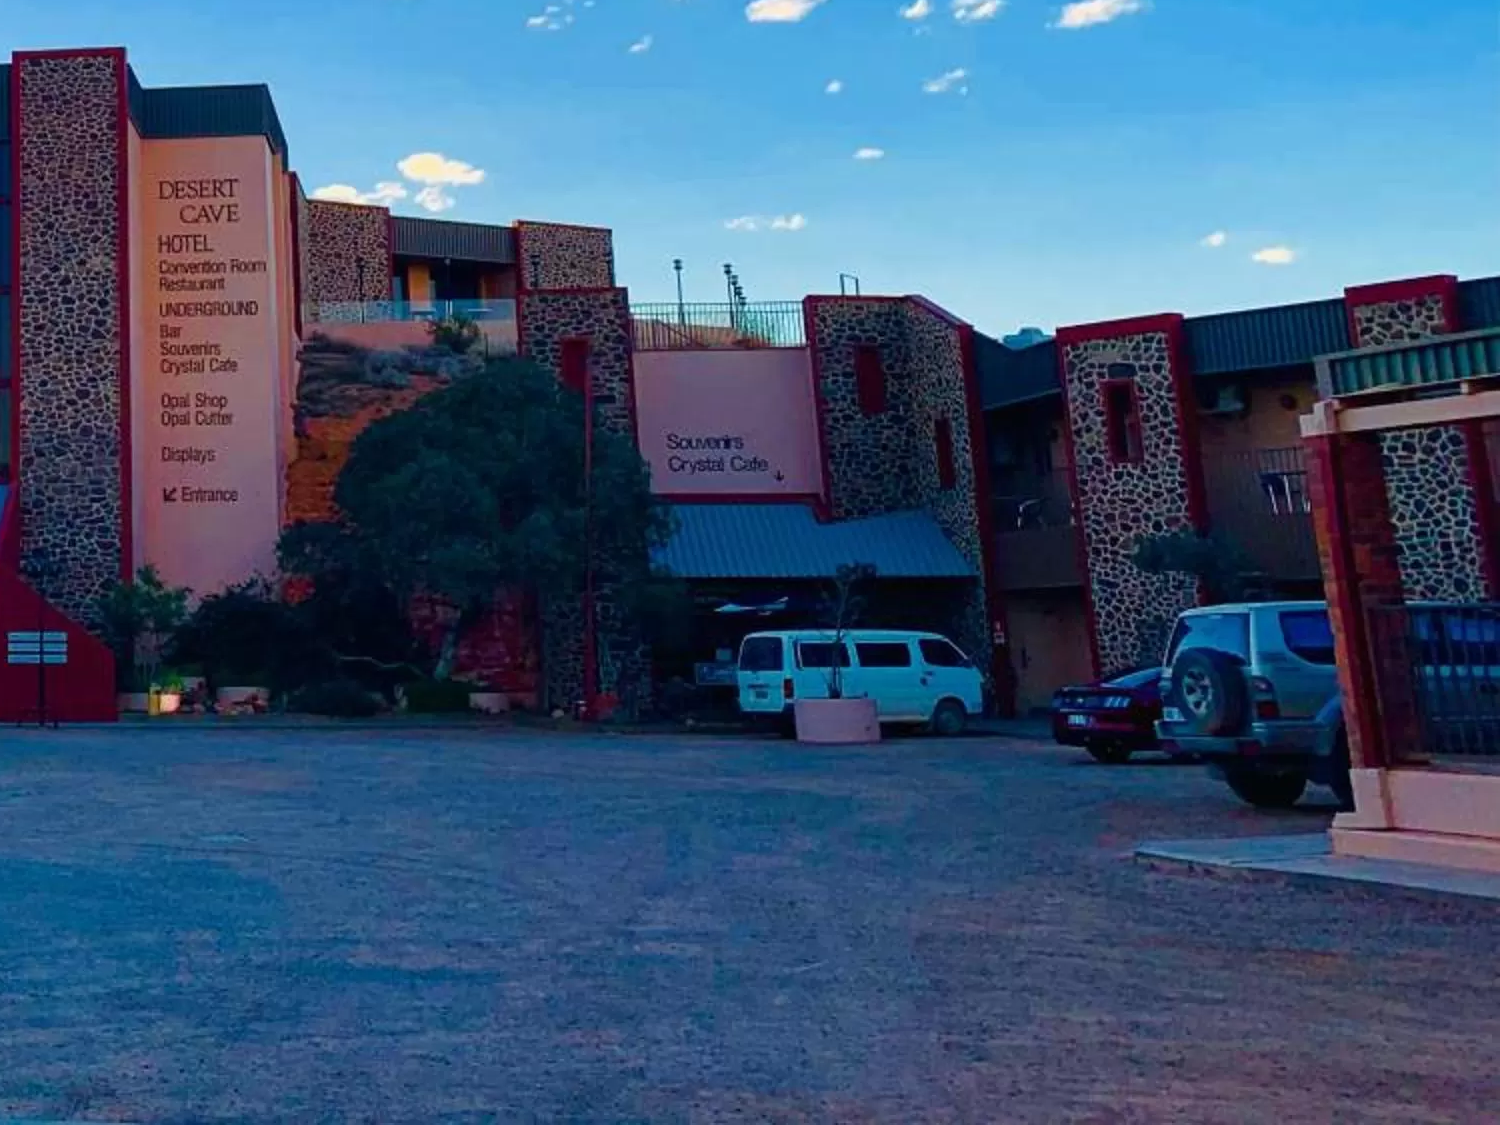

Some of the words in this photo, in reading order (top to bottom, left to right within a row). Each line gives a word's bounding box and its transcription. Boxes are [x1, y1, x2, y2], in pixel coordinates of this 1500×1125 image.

[158, 178, 240, 200] DESERT
[179, 203, 240, 224] CAVE
[157, 234, 215, 254] HOTEL
[158, 259, 226, 274] Convention
[230, 259, 267, 272] Room
[159, 277, 225, 292] Restaurant
[159, 301, 258, 317] UNDERGROUND
[159, 325, 182, 338] Bar
[159, 341, 221, 356] Souvenirs
[160, 359, 205, 376] Crystal
[160, 394, 190, 409] Opal
[195, 393, 228, 410] Shop
[160, 412, 190, 427] Opal
[195, 412, 233, 425] Cutter
[666, 433, 744, 450] Souvenirs
[161, 447, 216, 464] Displays
[668, 456, 724, 474] Crystal
[181, 488, 238, 502] Entrance
